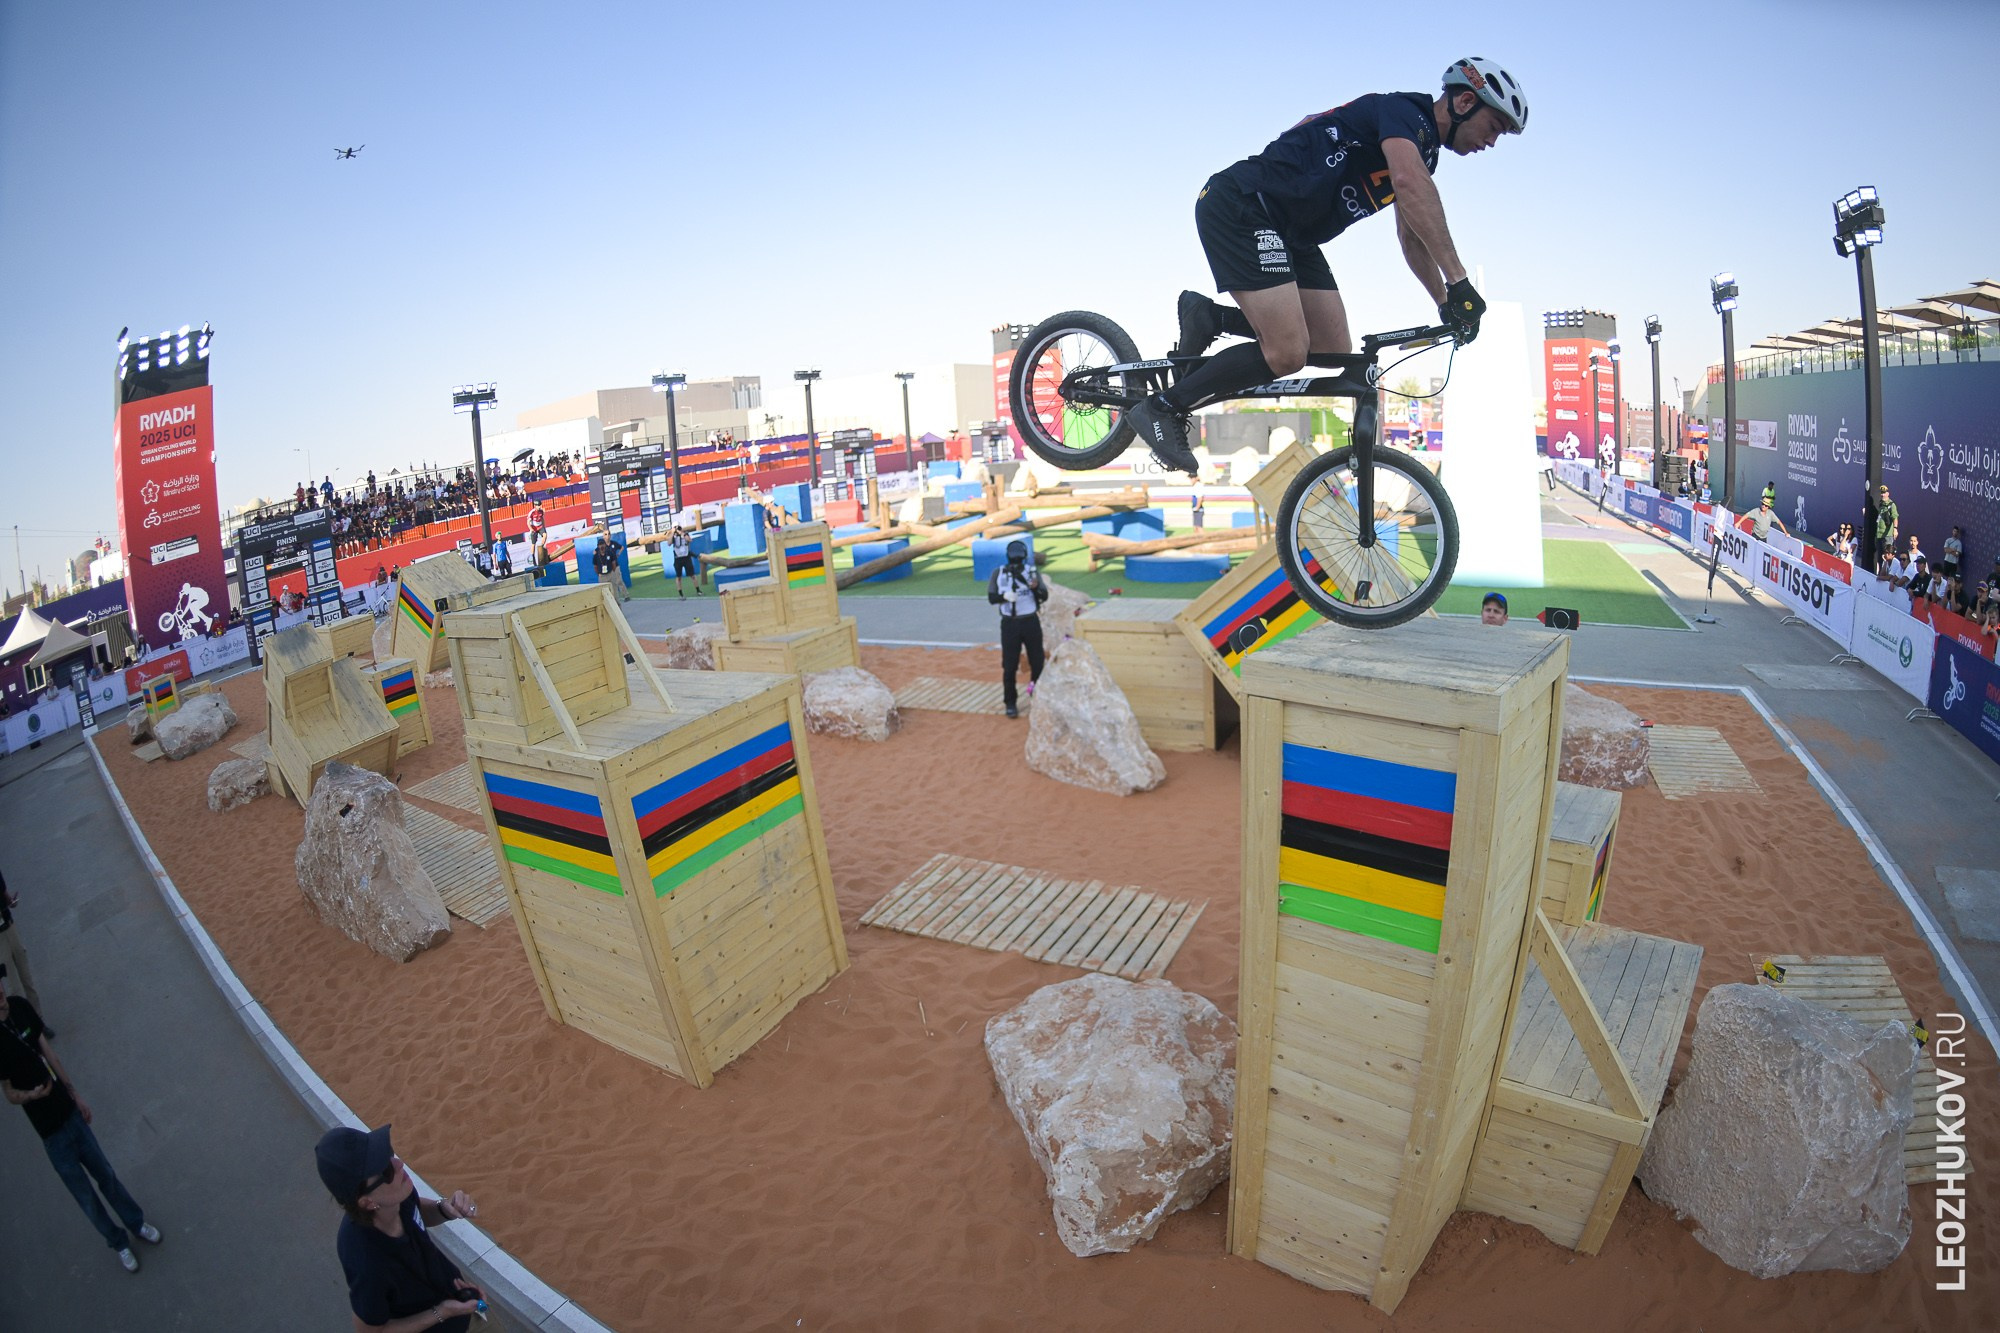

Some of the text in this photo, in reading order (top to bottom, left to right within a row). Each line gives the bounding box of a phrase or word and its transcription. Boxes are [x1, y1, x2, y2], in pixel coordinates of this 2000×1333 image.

[1552, 346, 1578, 355] RIYADH
[140, 404, 196, 431] RIYADH
[1788, 414, 1817, 438] RIYADH
[141, 424, 195, 447] 2025 UCI
[141, 439, 196, 456] URBAN CYCLING WORLD
[1788, 440, 1817, 462] 2025 UCI
[141, 447, 196, 464] CHAMPIONSHIPS
[1949, 442, 2000, 478] زارة الرياضة
[163, 475, 199, 488] وزارة الرياضة
[879, 480, 900, 489] ISSOT
[1788, 472, 1816, 486] CHAMPIONSHIPS
[163, 488, 180, 496] Ministry
[187, 483, 199, 491] Sport
[1948, 472, 2000, 502] Ministry of Spo
[162, 510, 178, 519] SAUDI
[179, 504, 200, 514] CYCLING
[1659, 505, 1682, 529] SHIMANO
[246, 527, 260, 537] UCI
[277, 536, 297, 546] FINISH
[1722, 532, 1748, 564] SSOT
[153, 545, 166, 553] UCI
[464, 552, 471, 560] 2
[248, 558, 262, 567] UCI
[1830, 567, 1844, 581] RIYADH
[1780, 560, 1835, 616] TISSOT
[327, 613, 340, 622] UCI
[1958, 633, 1982, 654] RIYADH
[164, 659, 181, 669] RIYADH
[73, 672, 85, 680] START
[78, 678, 84, 691] 1
[1984, 701, 2000, 720] 2025
